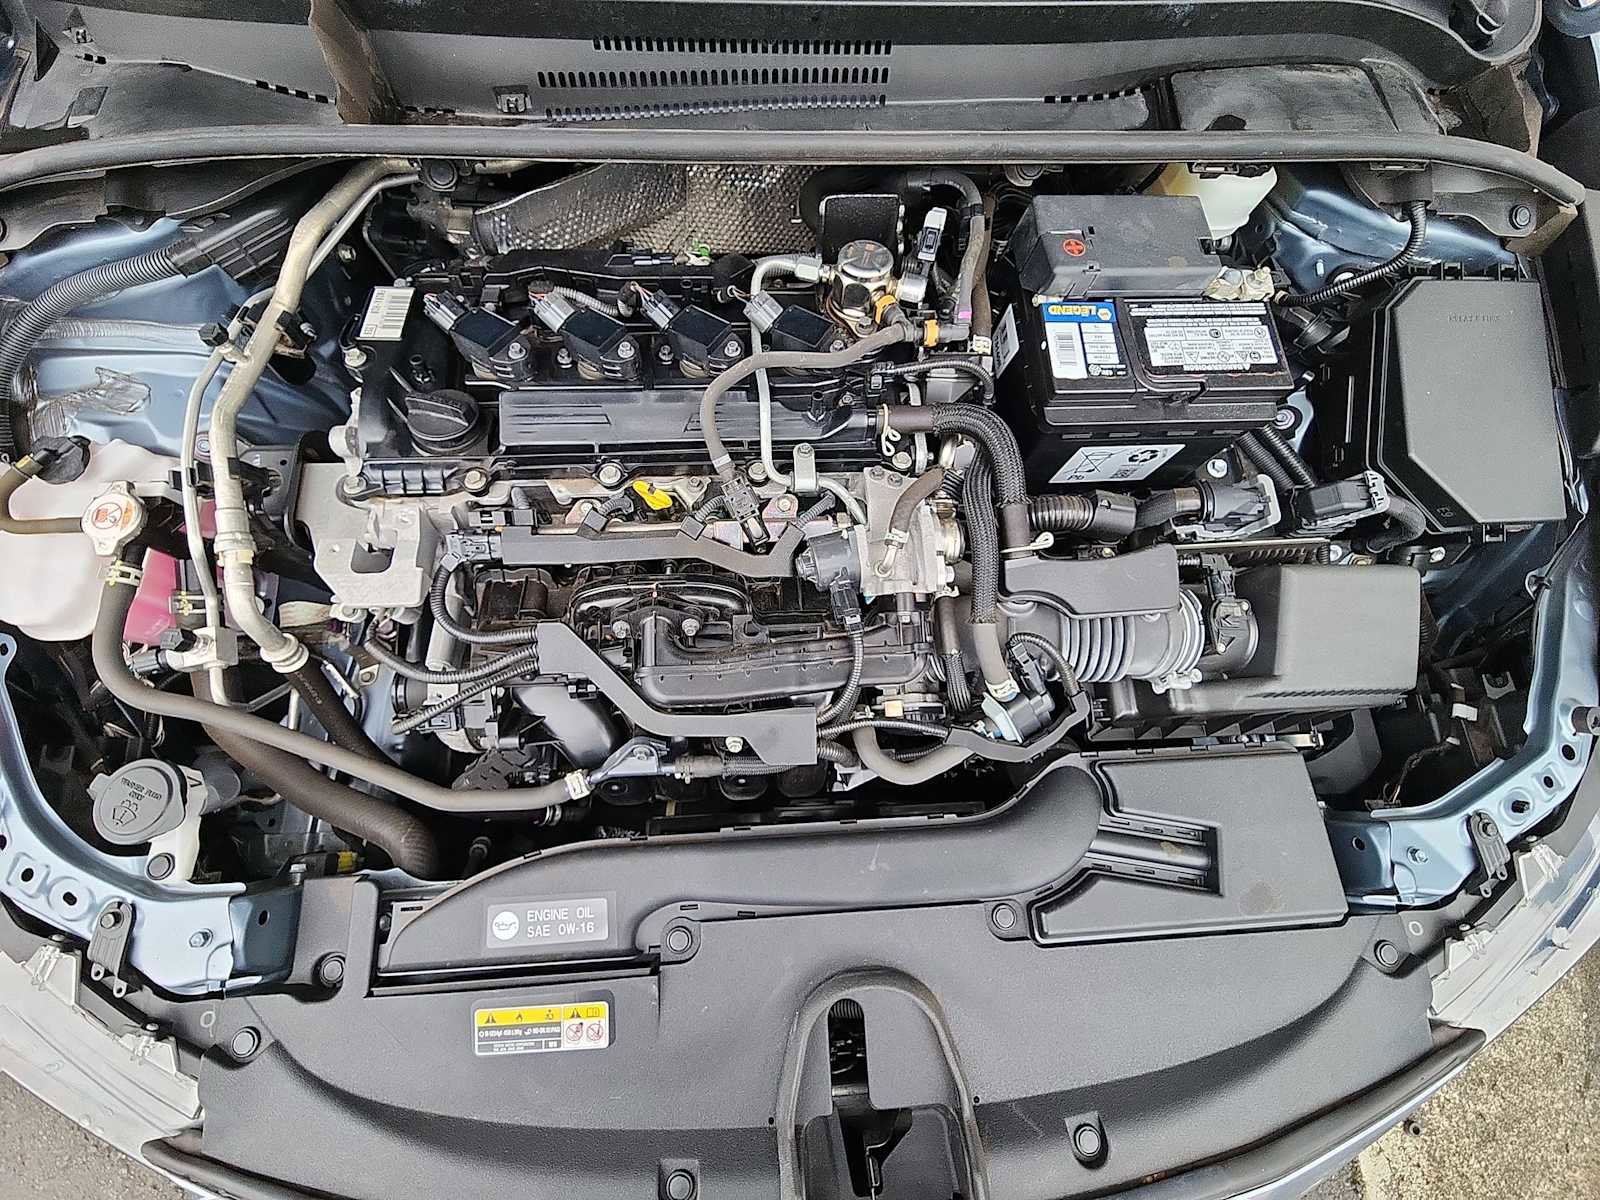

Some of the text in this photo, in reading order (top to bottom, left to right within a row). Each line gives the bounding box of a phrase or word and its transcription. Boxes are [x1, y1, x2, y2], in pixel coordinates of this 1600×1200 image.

[526, 906, 595, 922] ENGINE OIL
[526, 922, 595, 938] SAE 0W-16
